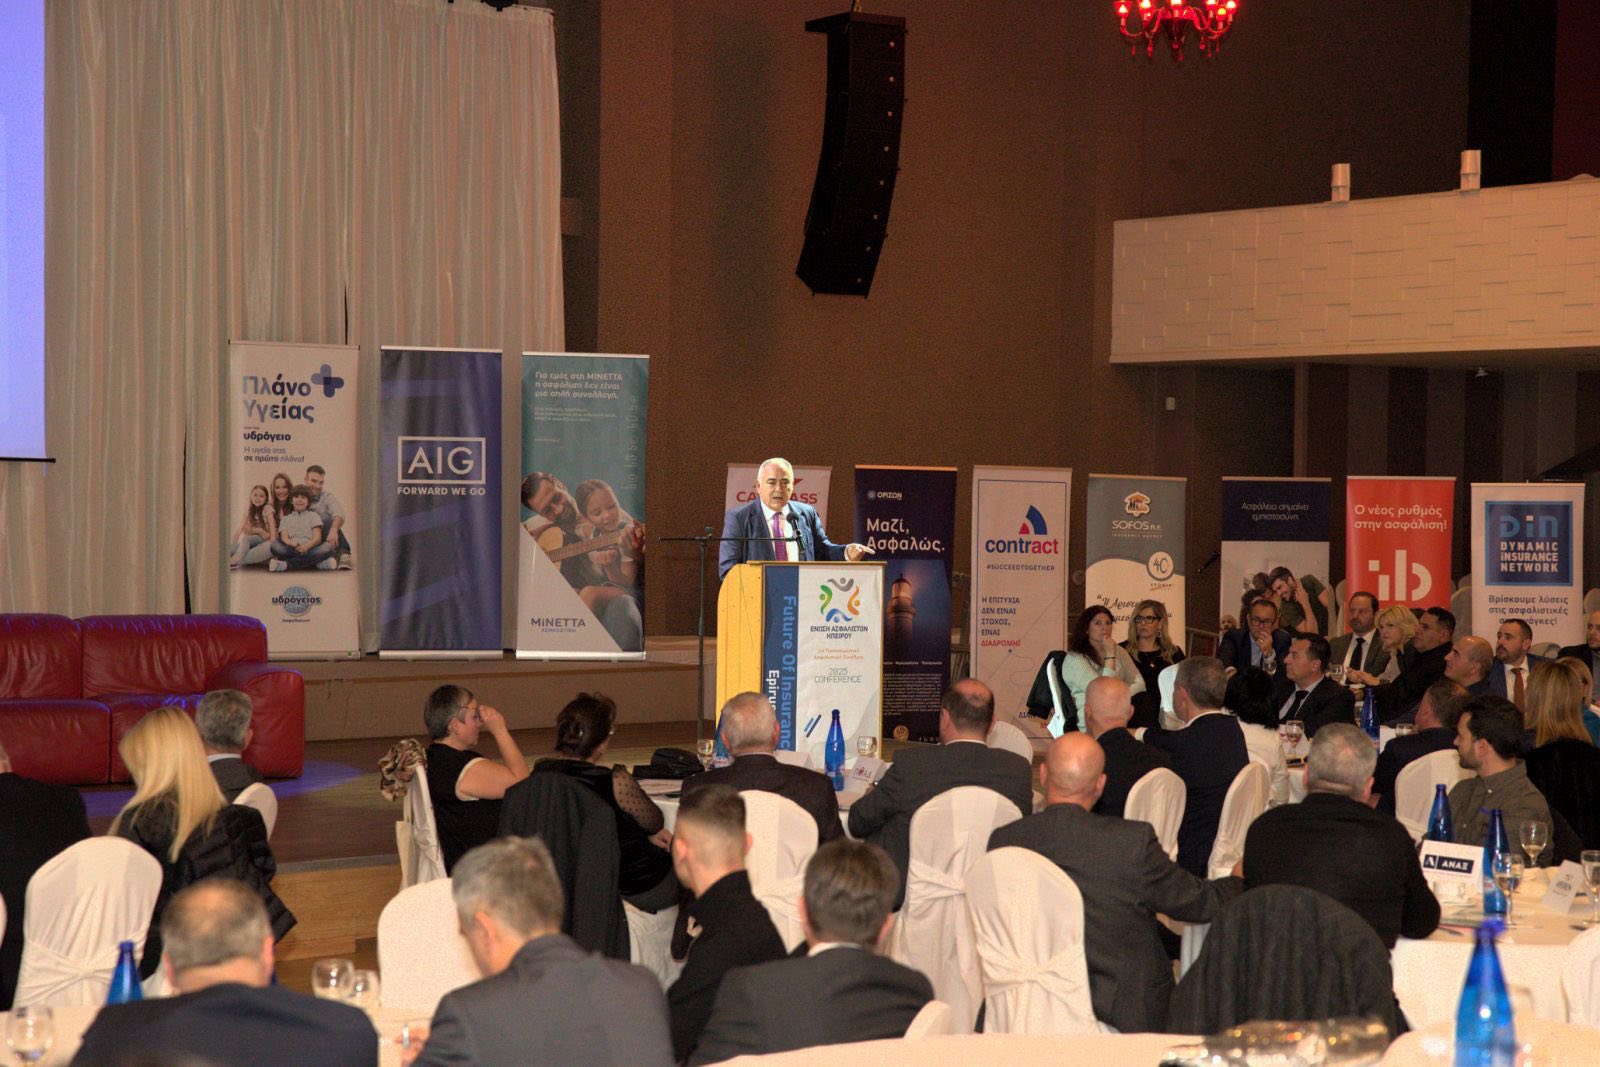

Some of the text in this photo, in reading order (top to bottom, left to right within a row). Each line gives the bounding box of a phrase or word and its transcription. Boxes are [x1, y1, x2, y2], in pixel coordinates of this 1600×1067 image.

[586, 372, 623, 381] MINETTA
[242, 373, 311, 396] Πλάνο
[243, 397, 315, 423] Υγείας
[244, 431, 291, 442] υδρόγειο
[244, 446, 250, 454] Η
[254, 455, 279, 463] πρώτο
[408, 446, 474, 475] AIG
[397, 486, 486, 496] FORWARD WE GO
[736, 492, 818, 504] CAASS
[1242, 502, 1277, 511] Ασφάλεια
[1354, 504, 1442, 518] Ο νέος ρυθμός
[866, 518, 910, 534] Μαζί,
[1112, 520, 1150, 530] SOFOS
[1354, 519, 1447, 532] στην ασφάλιση!
[866, 536, 946, 554] Ασφαλώς.
[985, 538, 1058, 554] contract
[1500, 542, 1558, 551] DYNAMIC
[1500, 562, 1558, 572] NETWORK
[272, 595, 321, 605] υδρόγειος
[1488, 594, 1568, 605] Βρίσκουμε λύσεις
[1488, 606, 1568, 616] στις ασφαλιστικές
[826, 632, 852, 640] ΗΠΕΙΡΟΥ
[780, 596, 797, 749] Future Of Insuranc
[829, 668, 848, 676] 2025
